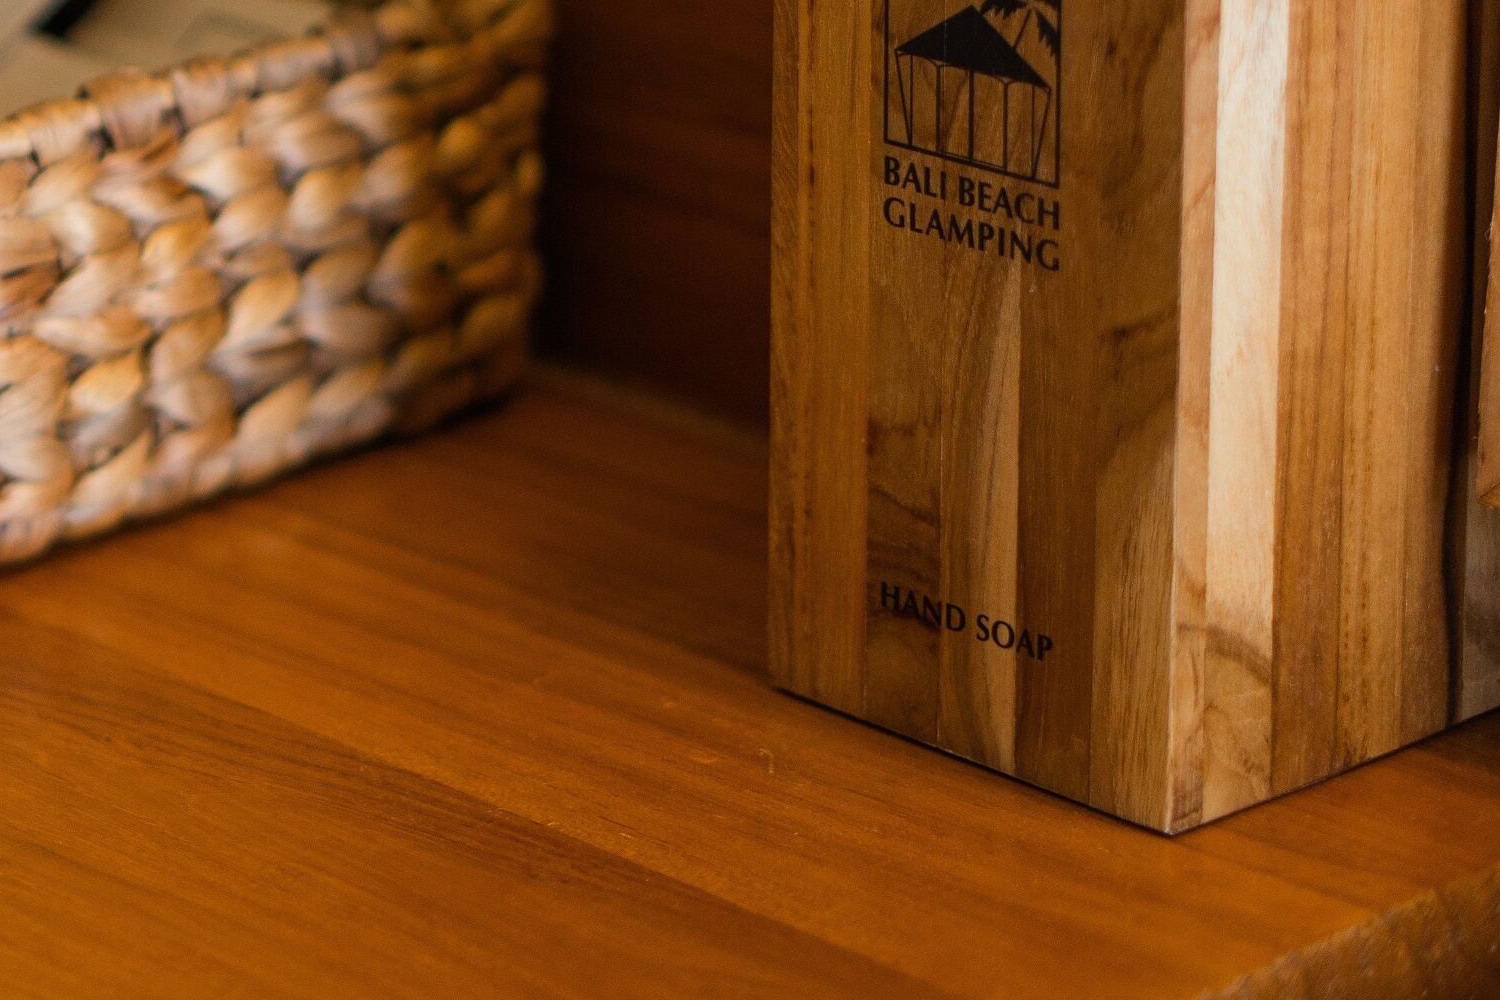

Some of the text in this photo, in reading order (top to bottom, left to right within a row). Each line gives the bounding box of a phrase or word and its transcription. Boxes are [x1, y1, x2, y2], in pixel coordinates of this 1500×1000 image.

[883, 155, 1060, 231] BALI BEACH
[883, 197, 1060, 272] GLAMPING
[880, 581, 1053, 661] HAND SOAP
